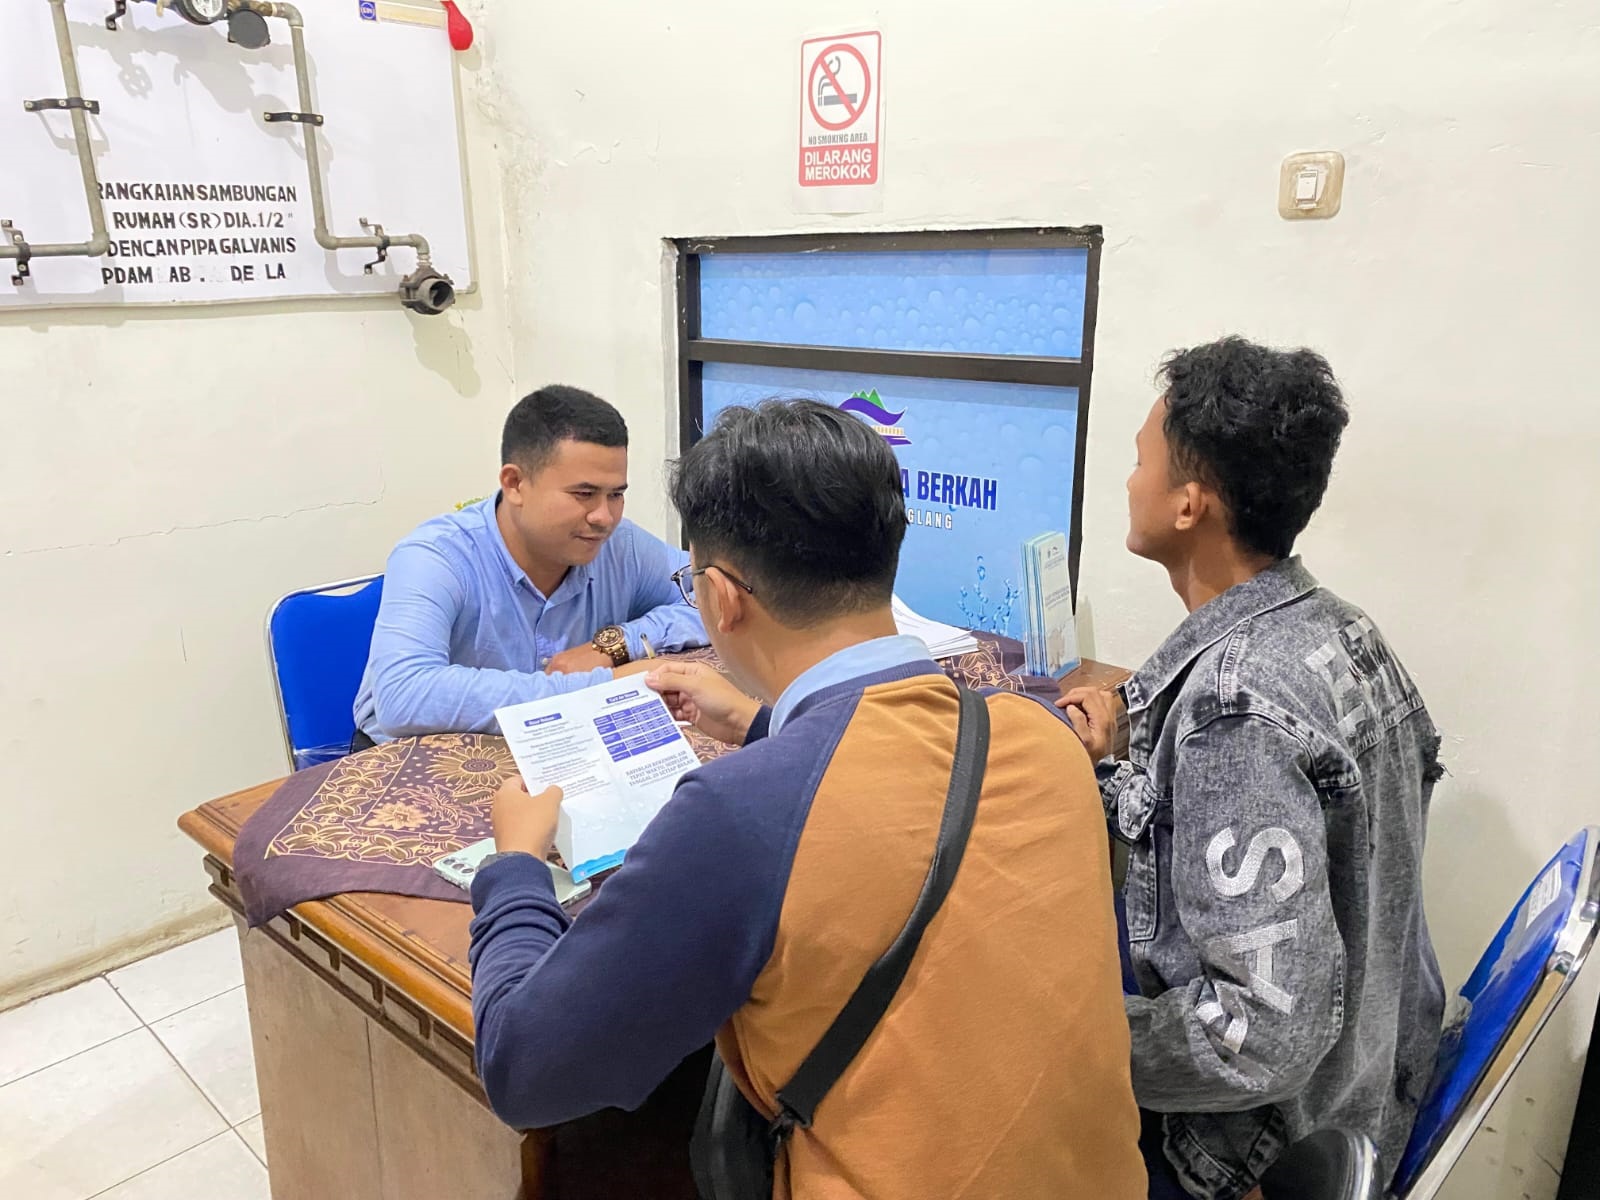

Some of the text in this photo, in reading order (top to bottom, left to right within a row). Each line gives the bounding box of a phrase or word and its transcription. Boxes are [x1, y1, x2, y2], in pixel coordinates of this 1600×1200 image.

[808, 132, 868, 145] NO SMOKING AREA
[804, 148, 872, 166] DILARANG
[805, 164, 871, 181] MEROKOK
[196, 184, 297, 202] SAMBUNGAN
[112, 212, 176, 229] RUMAH
[181, 238, 218, 255] PIPA
[220, 237, 297, 254] GALVANIS
[101, 266, 153, 284] PDAM
[917, 470, 997, 511] BERKAH
